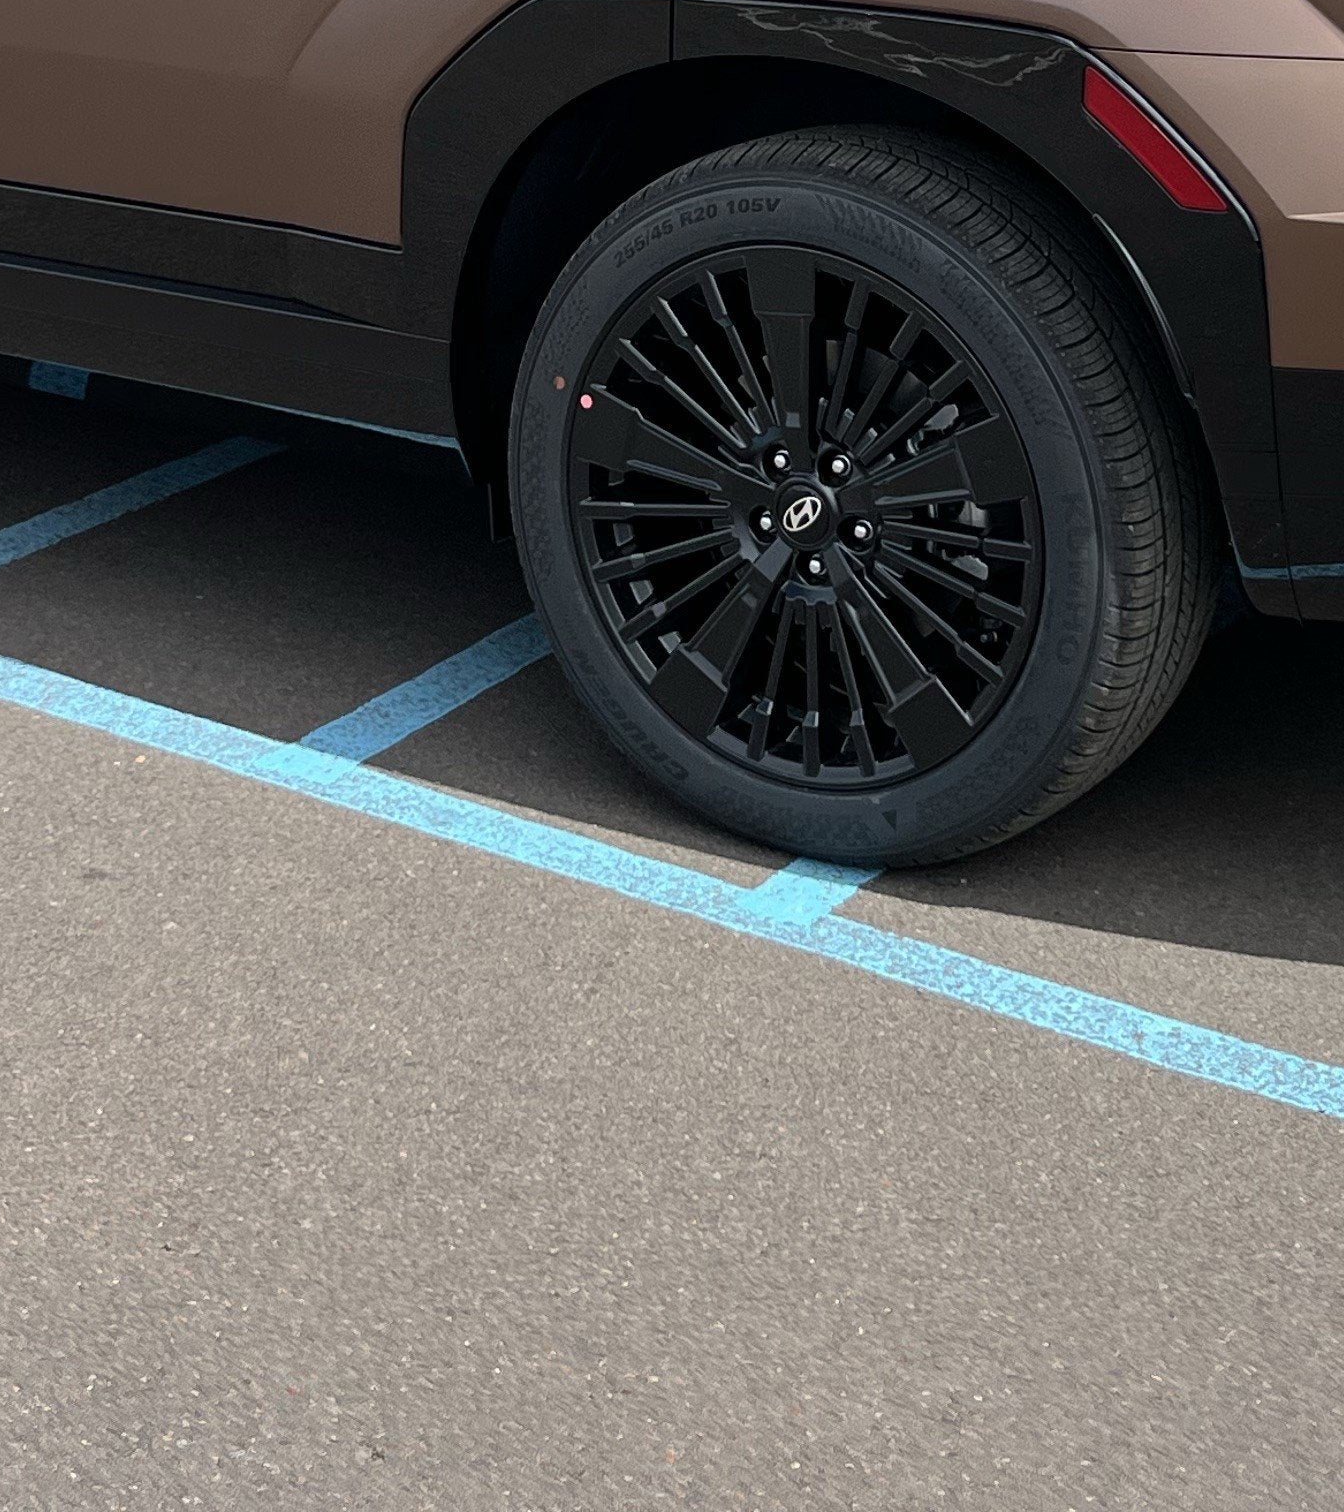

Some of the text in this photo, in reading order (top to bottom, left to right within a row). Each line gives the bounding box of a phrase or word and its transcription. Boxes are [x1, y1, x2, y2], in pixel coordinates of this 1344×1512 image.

[614, 197, 783, 269] 255/45 R20 105V
